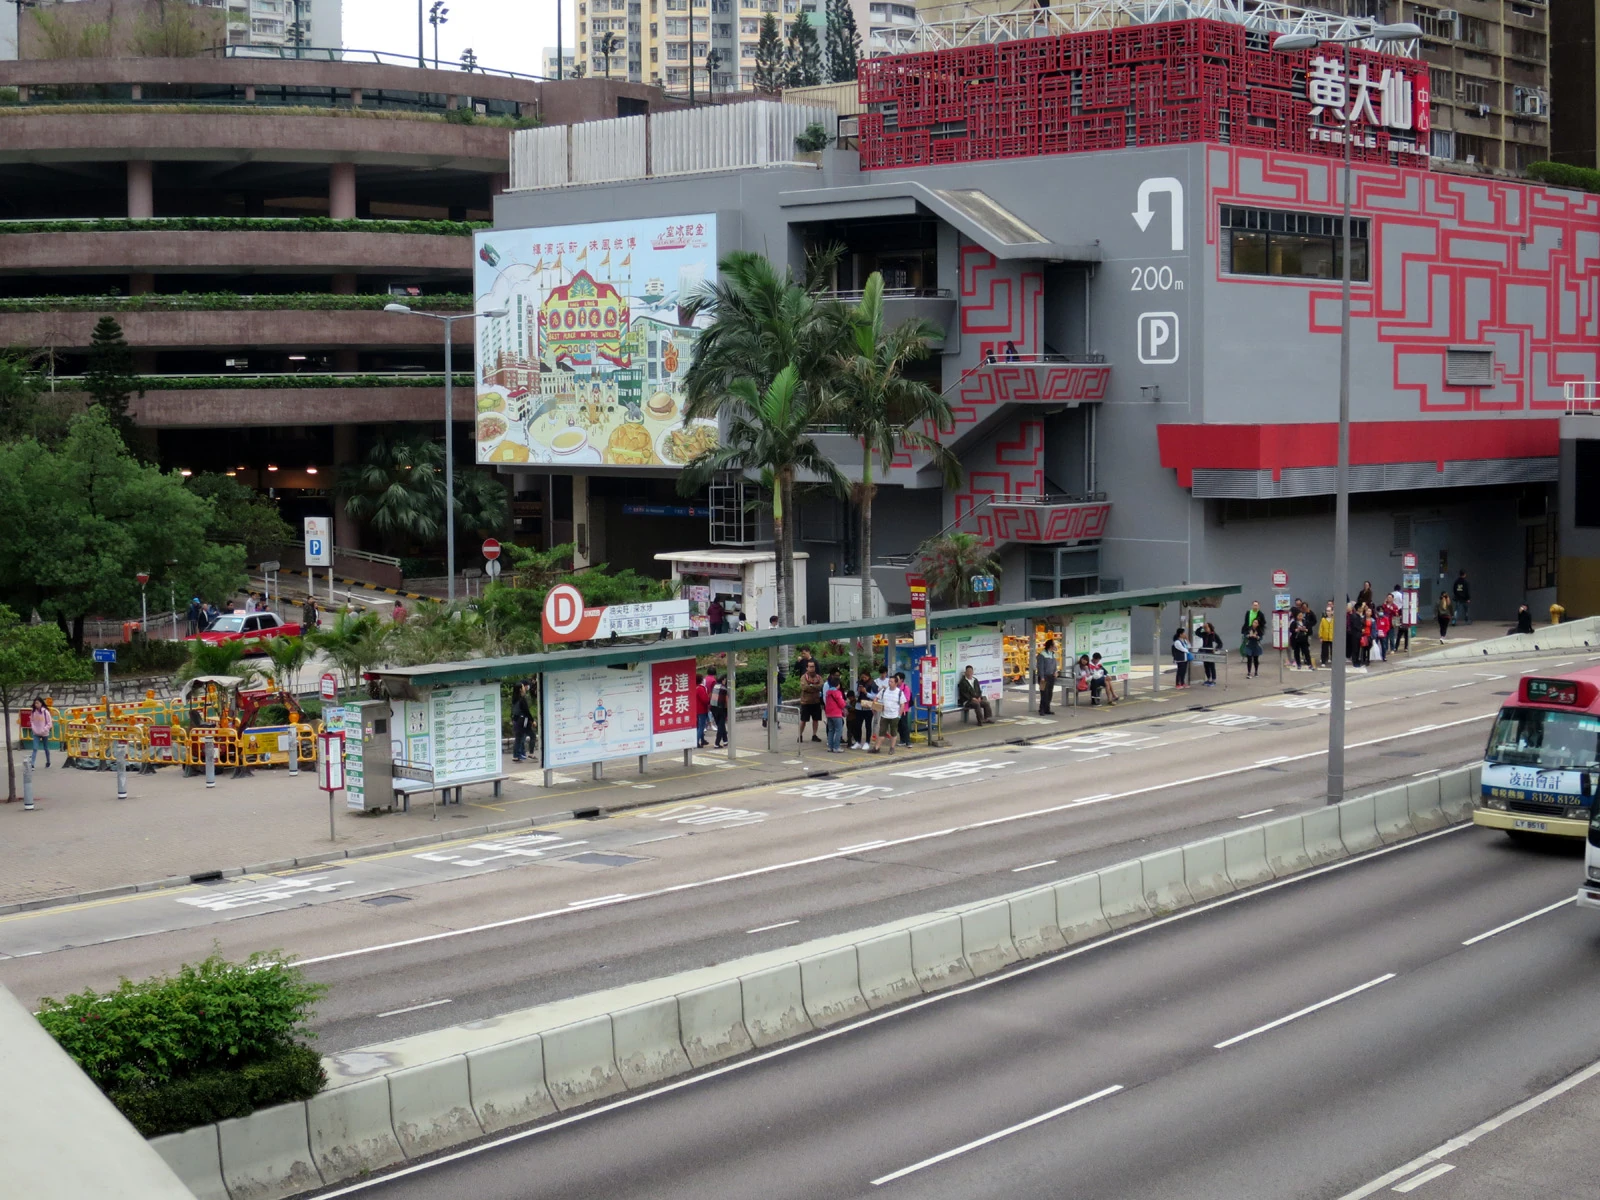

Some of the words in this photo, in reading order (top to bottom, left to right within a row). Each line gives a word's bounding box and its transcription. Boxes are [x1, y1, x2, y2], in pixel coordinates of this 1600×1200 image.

[1308, 56, 1412, 130] 黃大仙
[1417, 87, 1429, 130] 中心
[1308, 127, 1376, 148] TEMPLE
[1388, 141, 1429, 156] MALL
[1150, 319, 1170, 357] P
[312, 541, 320, 554] P
[554, 593, 576, 627] D
[1532, 793, 1554, 803] 8126
[1557, 795, 1580, 805] 8126
